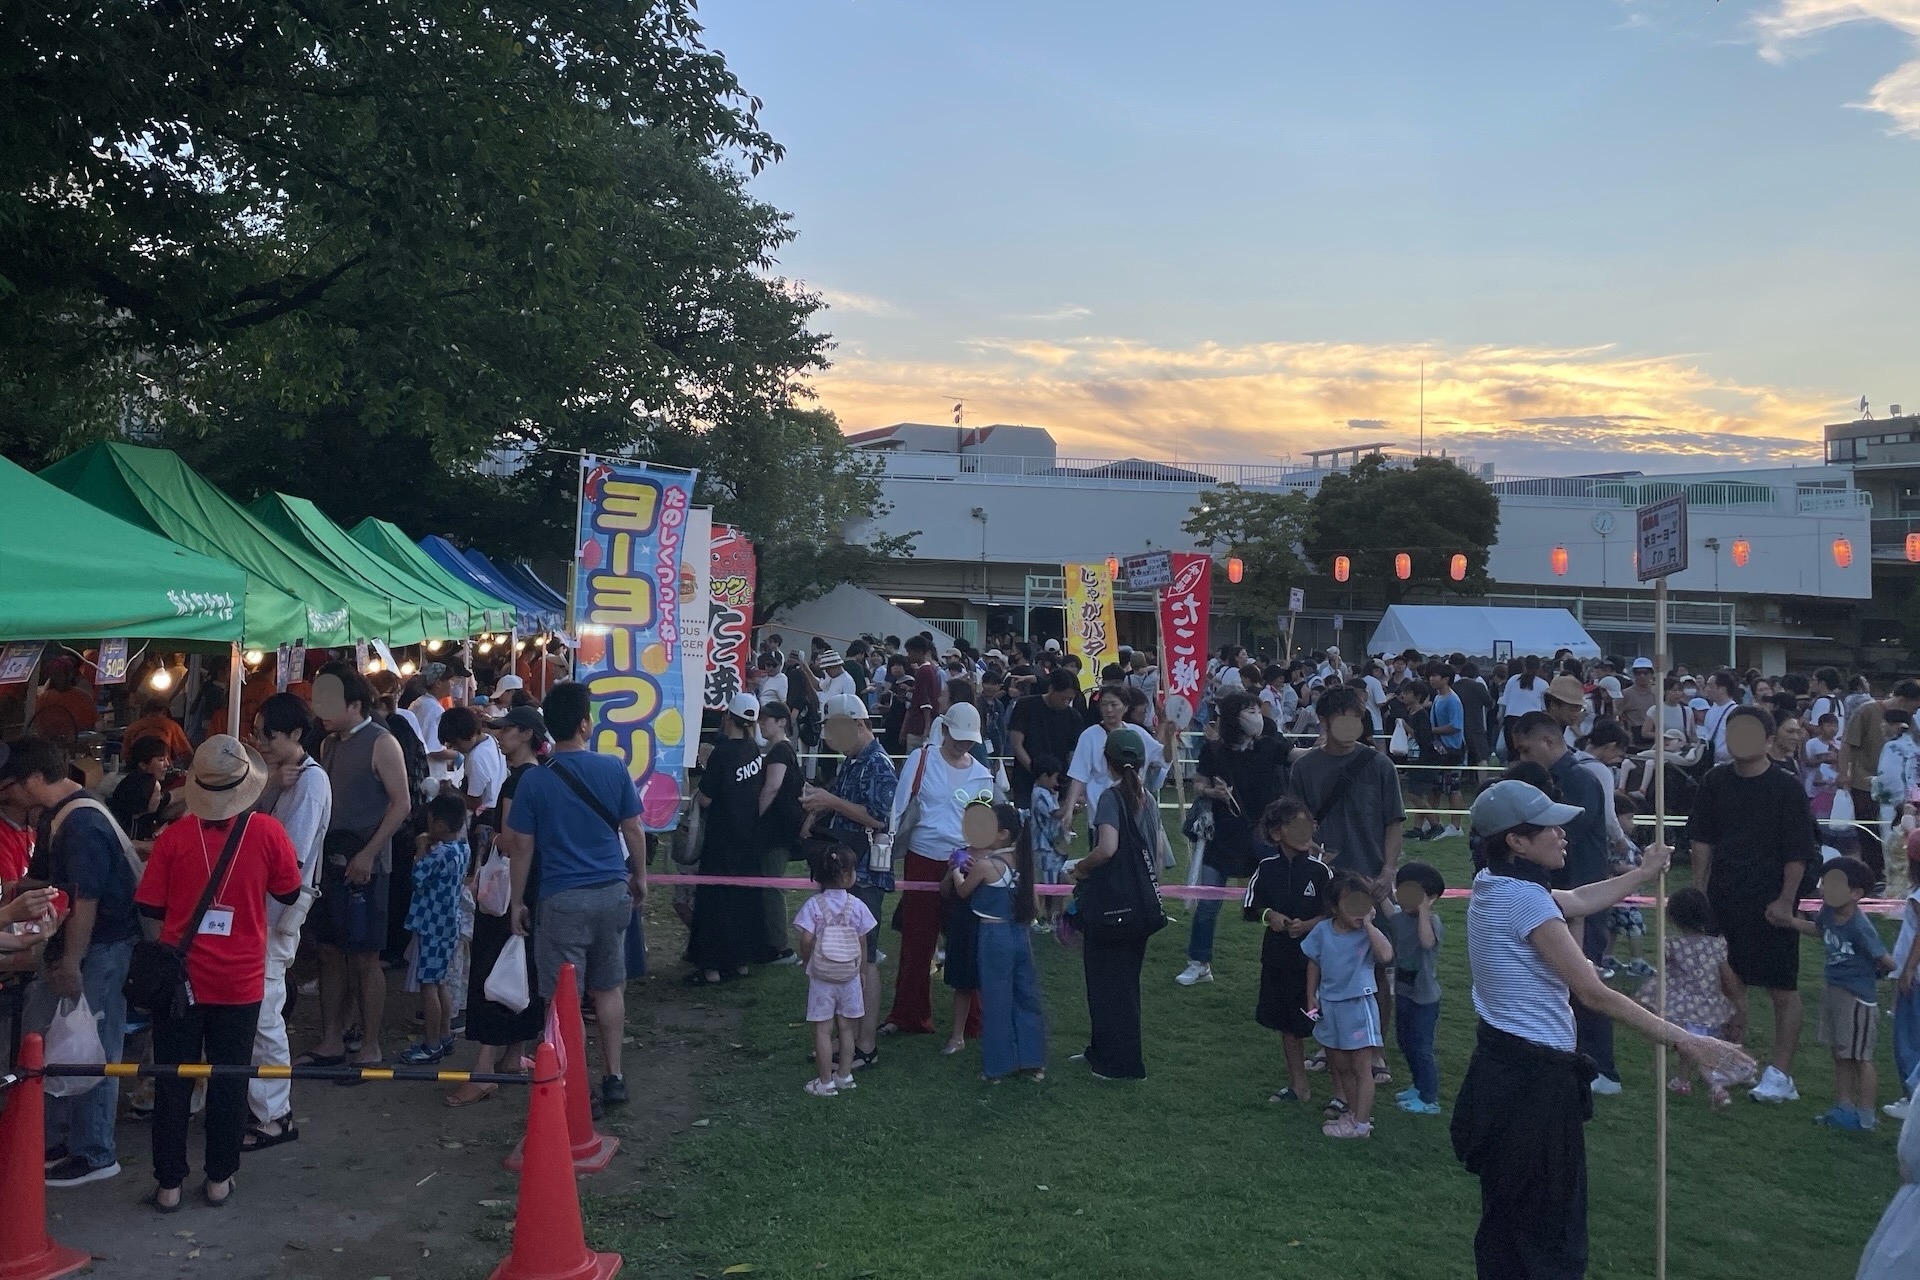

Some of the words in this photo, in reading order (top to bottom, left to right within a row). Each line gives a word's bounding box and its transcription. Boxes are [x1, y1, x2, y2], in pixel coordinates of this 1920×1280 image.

[589, 478, 660, 784] ヨーヨーつり
[1080, 567, 1106, 677] じゃがバター
